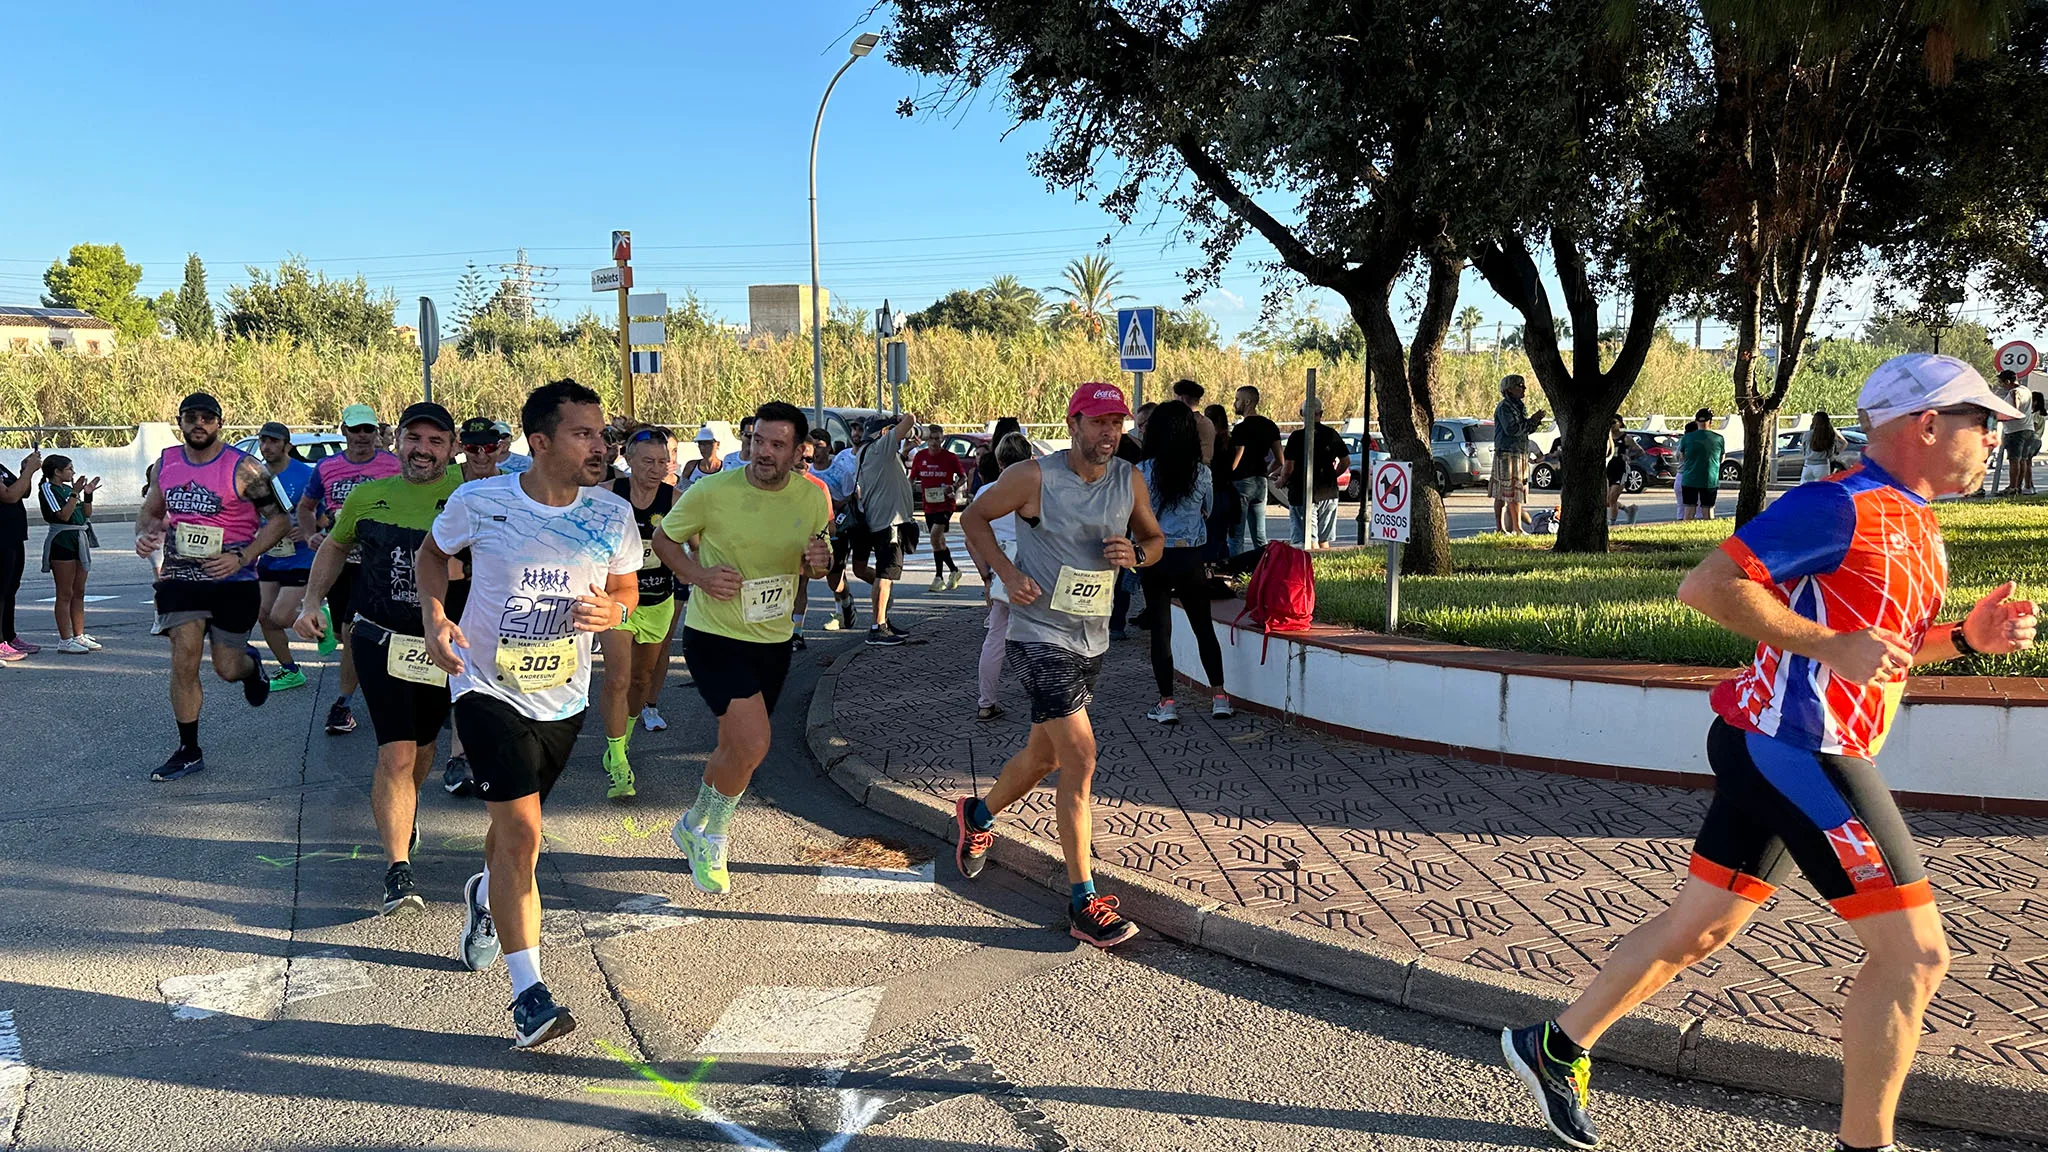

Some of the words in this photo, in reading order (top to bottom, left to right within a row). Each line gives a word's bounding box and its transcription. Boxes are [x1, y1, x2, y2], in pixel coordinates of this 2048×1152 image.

[596, 273, 619, 284] Poblets
[2003, 353, 2028, 366] 30
[165, 489, 212, 504] LOCAL
[1374, 513, 1408, 528] GOSSOS
[187, 533, 209, 545] 100
[1382, 526, 1398, 539] NO
[760, 587, 783, 604] 177
[1071, 583, 1102, 598] 207
[499, 595, 577, 635] 21K
[518, 655, 561, 671] 303
